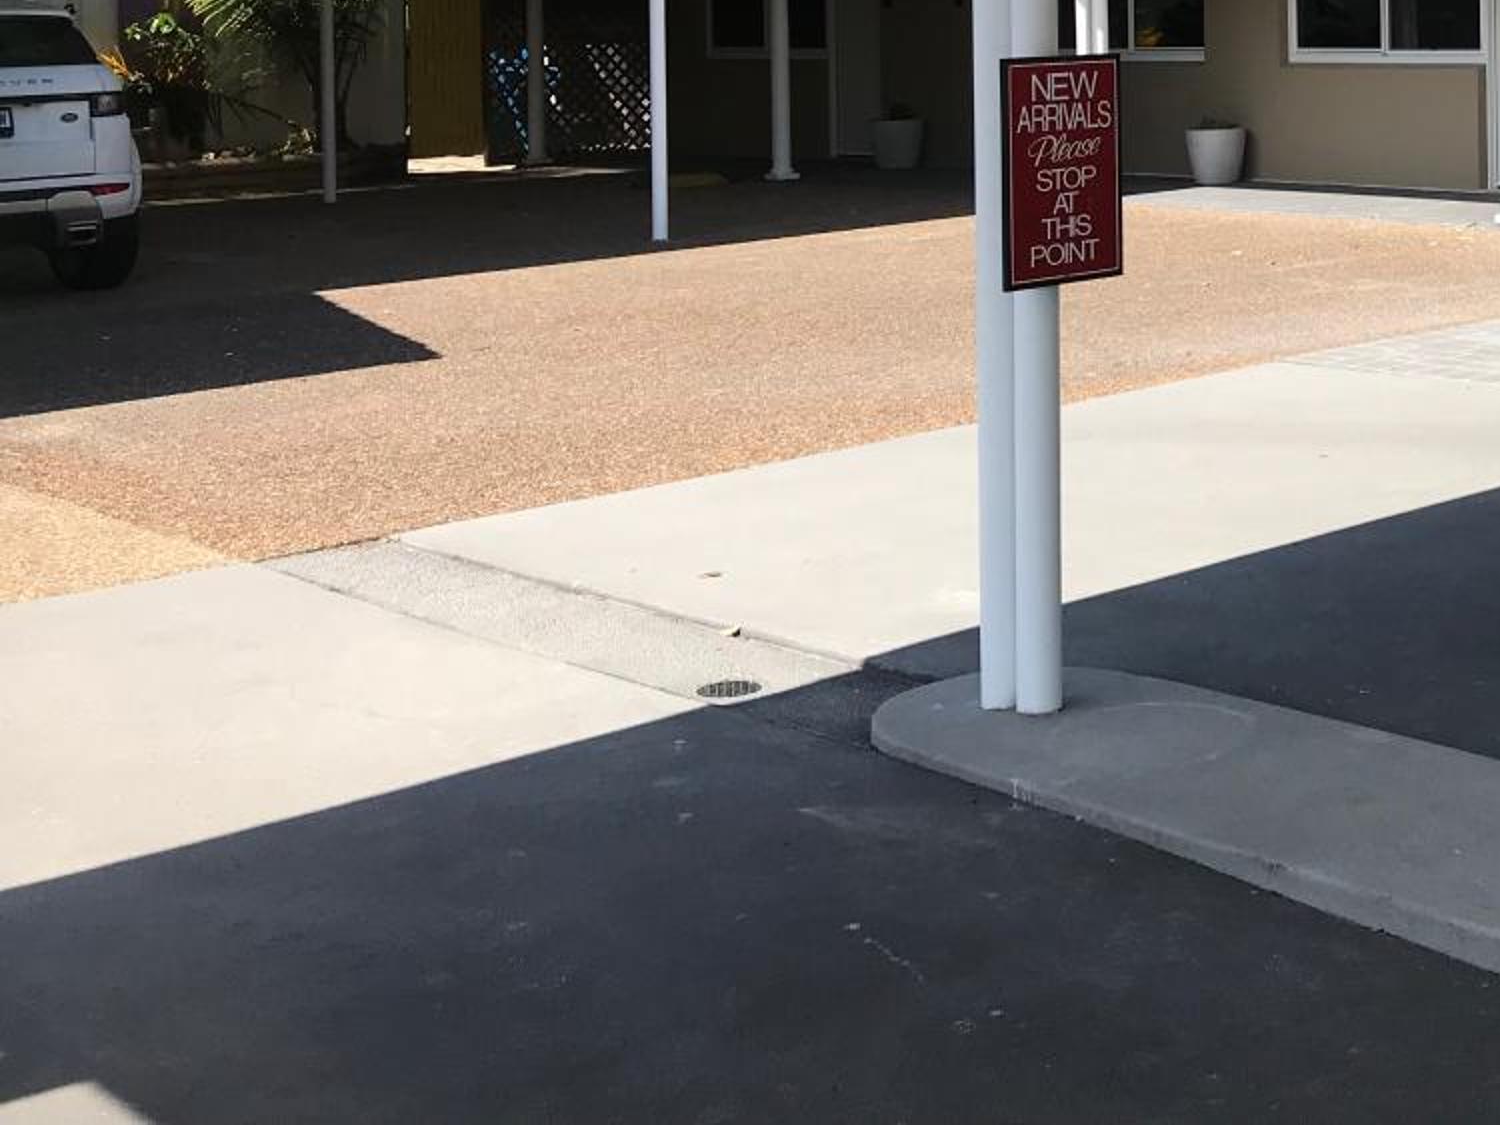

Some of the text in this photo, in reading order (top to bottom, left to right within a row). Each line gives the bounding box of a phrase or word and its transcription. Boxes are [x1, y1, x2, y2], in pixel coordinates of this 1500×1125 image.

[1030, 70, 1099, 103] NEW
[1016, 100, 1112, 134] ARRIVALS
[1027, 133, 1101, 168] Please
[1035, 166, 1097, 192] STOP
[1053, 191, 1080, 215] AT
[1041, 214, 1093, 240] THIS
[1030, 239, 1100, 268] POINT
